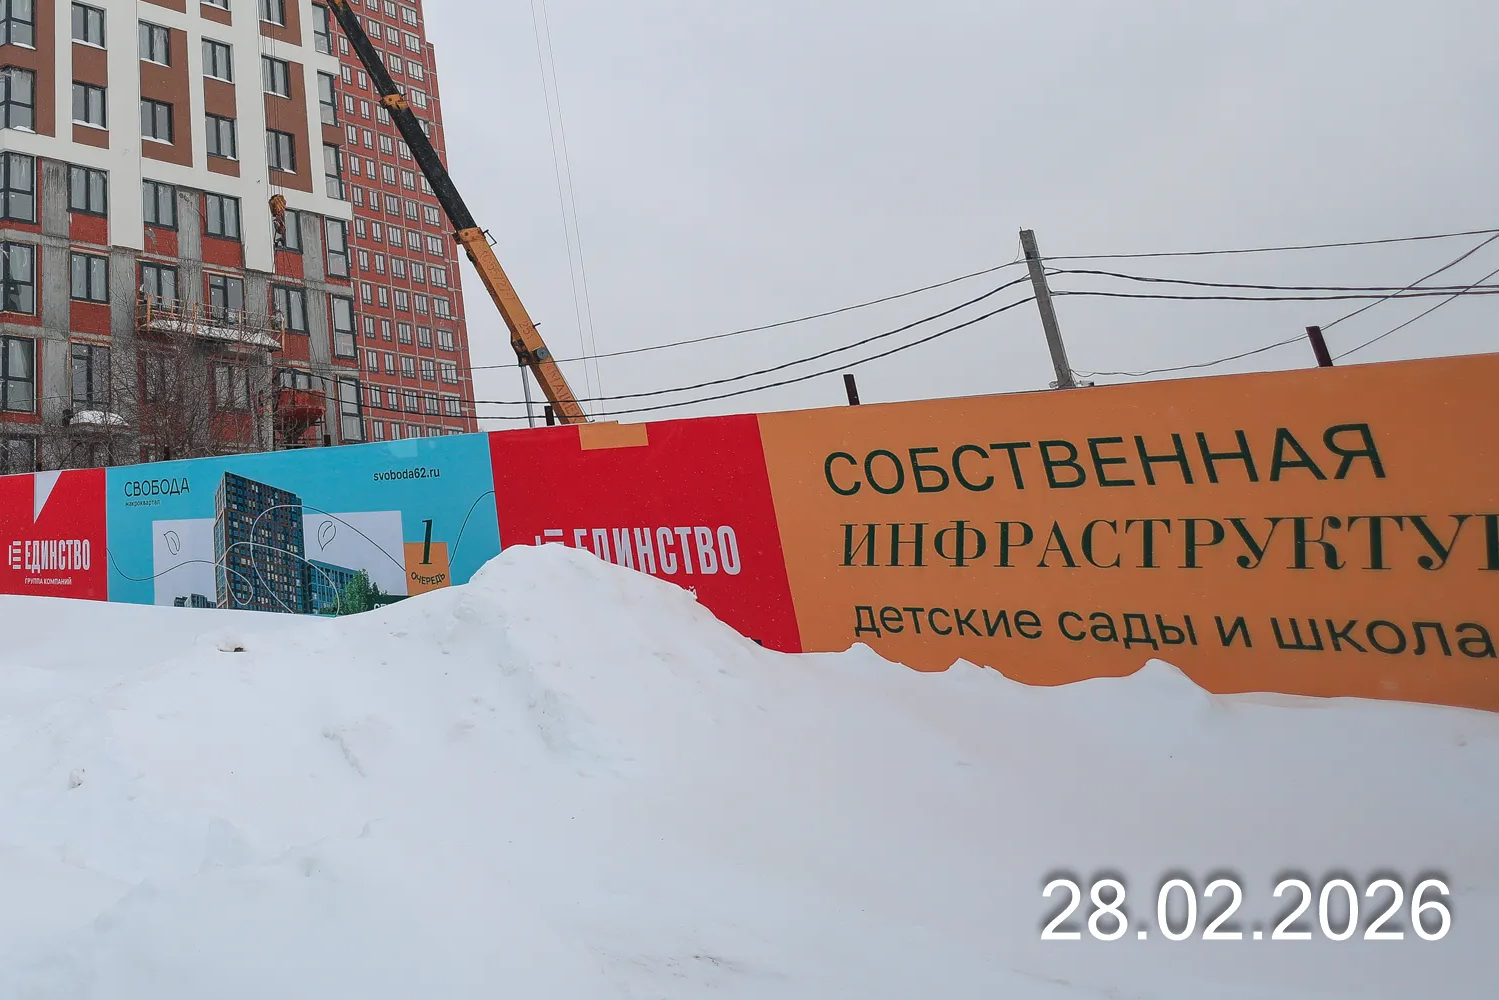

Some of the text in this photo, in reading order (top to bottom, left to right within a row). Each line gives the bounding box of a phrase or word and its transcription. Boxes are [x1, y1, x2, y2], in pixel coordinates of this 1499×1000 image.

[824, 423, 1387, 496] СОБСТВЕННАЯ
[124, 477, 190, 497] СВОБОДА
[373, 467, 441, 482] svoboda62.ru
[419, 519, 433, 565] 1
[25, 539, 90, 573] ЕДИНСТВО
[43, 577, 72, 585] КОМПАНИЙ
[411, 571, 446, 586] ОЧЕРЕДЬ
[854, 604, 1498, 659] детские сады и школа
